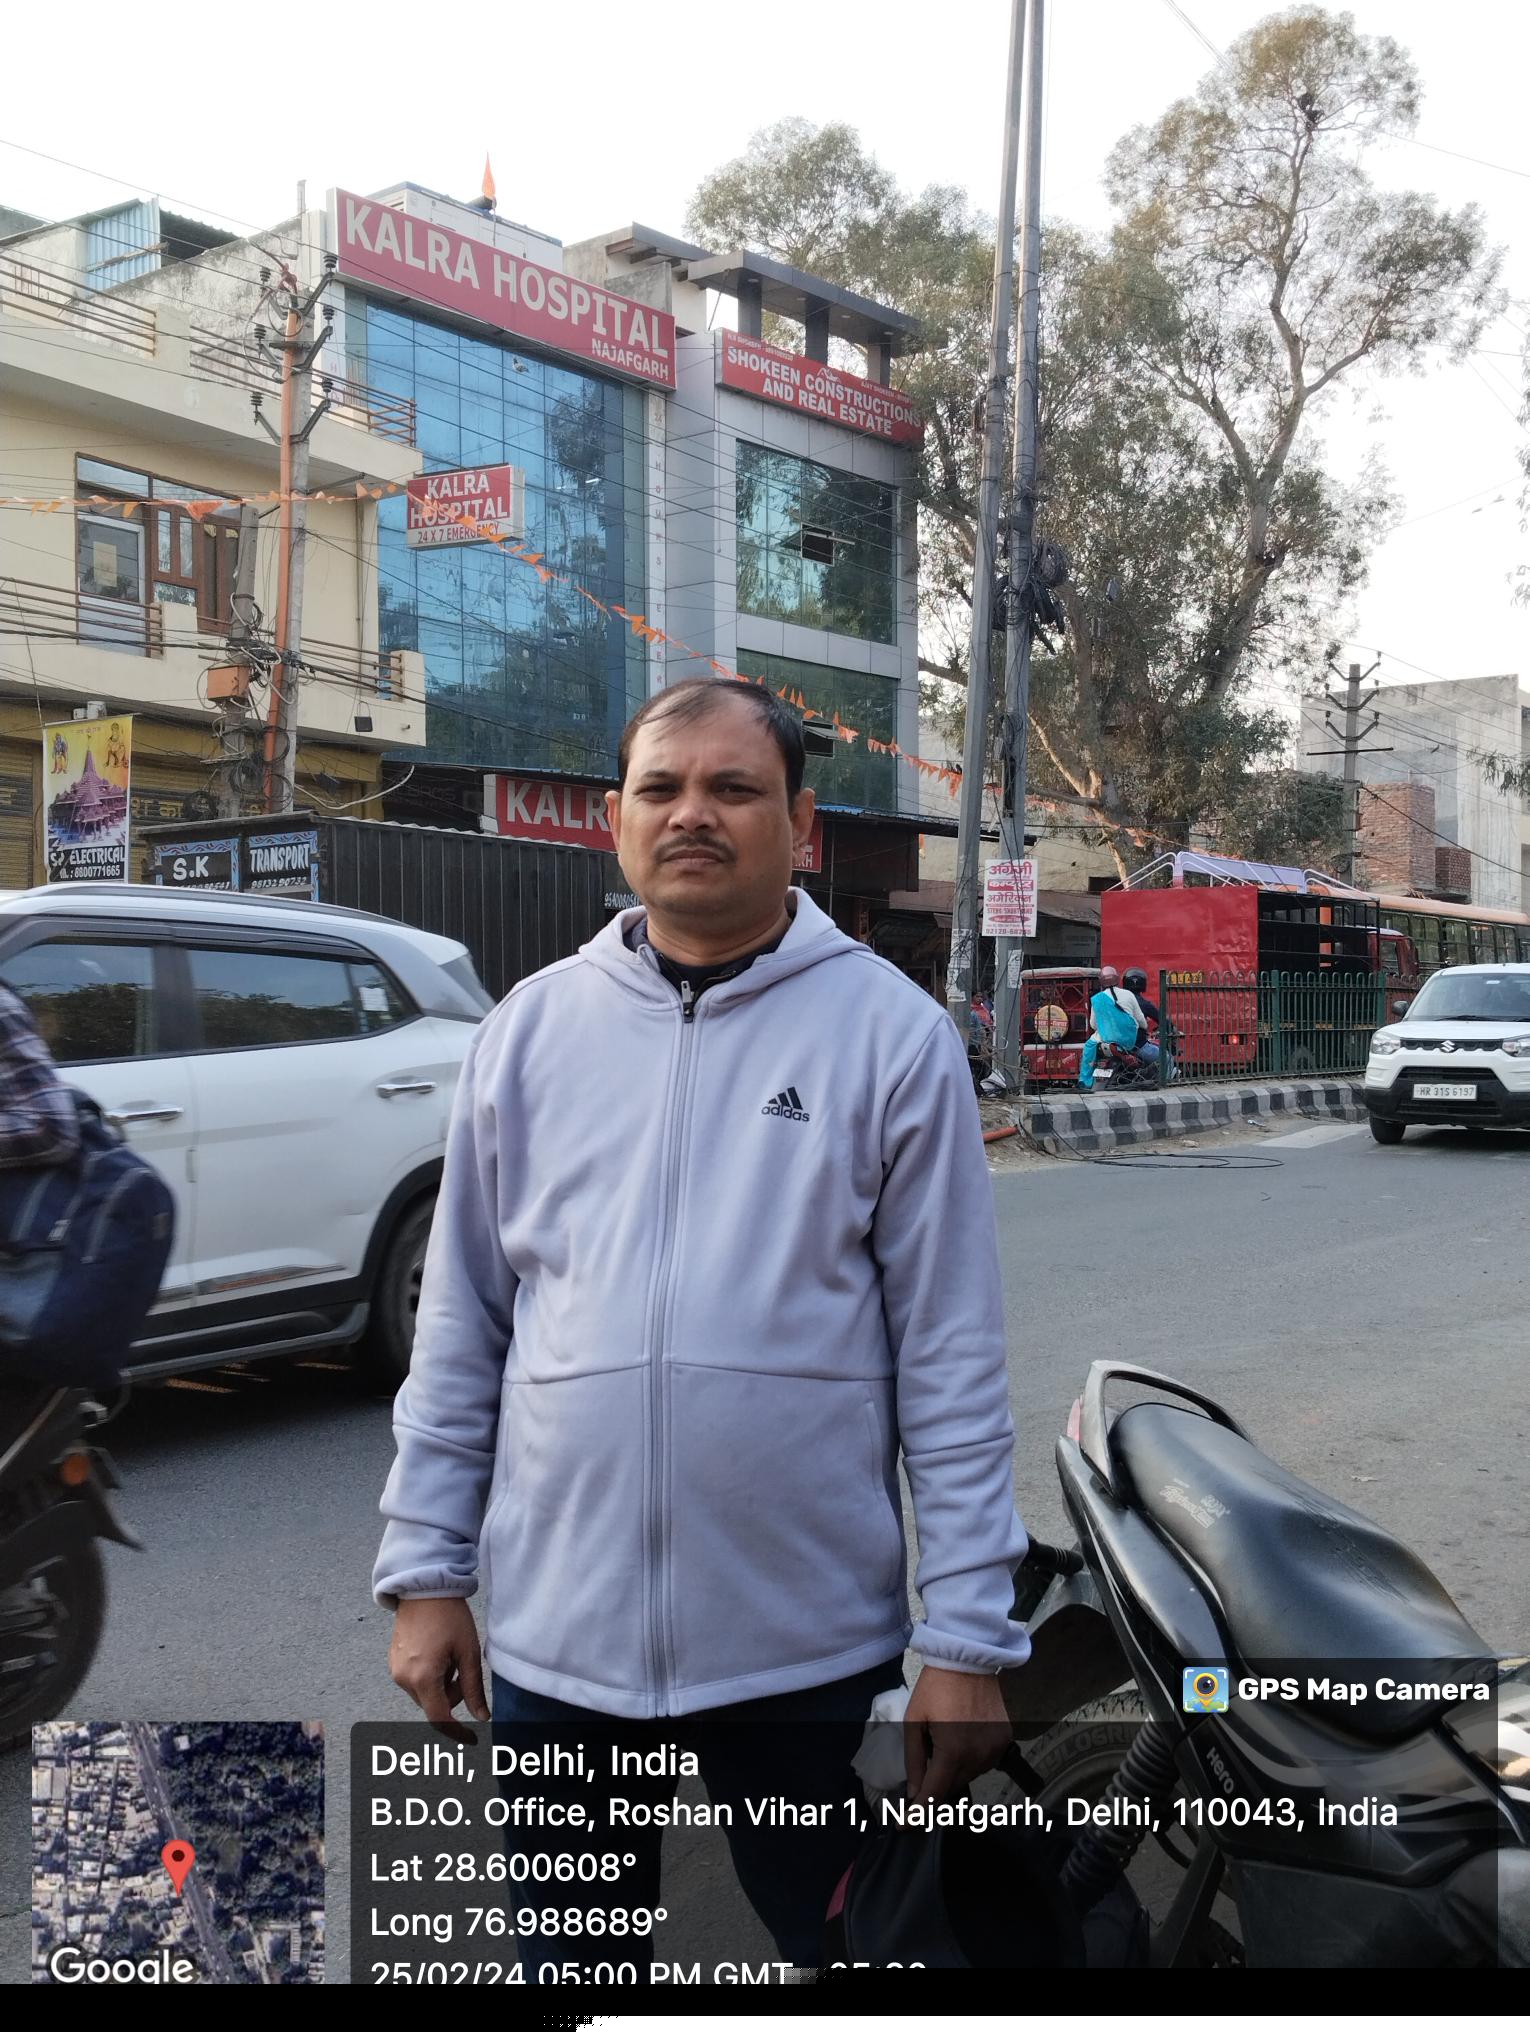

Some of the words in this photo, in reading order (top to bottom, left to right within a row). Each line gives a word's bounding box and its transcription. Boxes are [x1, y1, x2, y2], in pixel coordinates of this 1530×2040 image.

[346, 198, 480, 289] KALRA
[493, 254, 669, 358] HOSPITAL
[591, 338, 669, 381] NAJAFGARH
[727, 346, 801, 386] SHOKEEN
[805, 373, 922, 428] CONSTRUCTIONS
[762, 378, 794, 402] AND
[799, 390, 835, 417] REAL
[840, 404, 893, 435] ESTATE
[427, 473, 490, 500] KALRA
[410, 496, 508, 528] HOSPITAL
[418, 531, 428, 544] 24
[431, 529, 436, 543] X
[439, 528, 444, 542] 7
[507, 780, 612, 832] KALR
[69, 847, 125, 865] ELECTRICAL
[172, 855, 209, 881] S.K
[249, 843, 310, 873] TRANSPORT
[1420, 1087, 1431, 1096] HR
[761, 1104, 810, 1122] adidas
[1206, 1746, 1235, 1794] Hero
